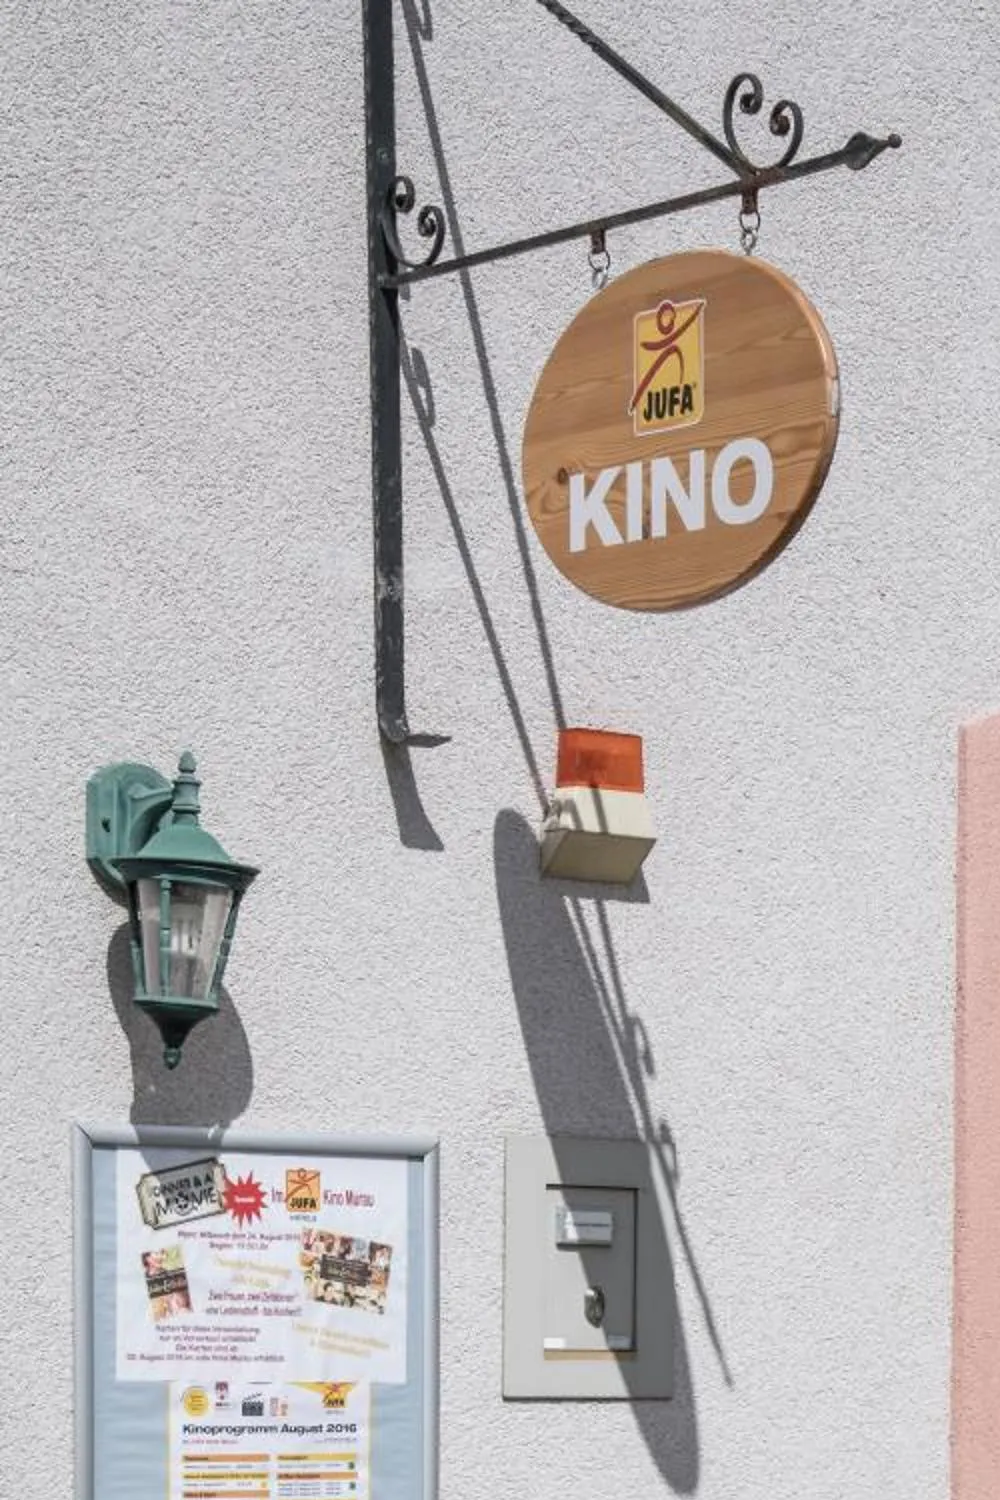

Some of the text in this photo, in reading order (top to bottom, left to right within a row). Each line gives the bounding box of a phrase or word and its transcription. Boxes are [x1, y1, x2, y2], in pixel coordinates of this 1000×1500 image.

[643, 383, 694, 422] JUFA
[568, 437, 774, 553] KINO
[155, 1186, 218, 1217] MOVIE
[289, 1197, 318, 1210] JUFA
[323, 1189, 344, 1208] Kino
[183, 1423, 357, 1436] Kinoprogramm August 2016
